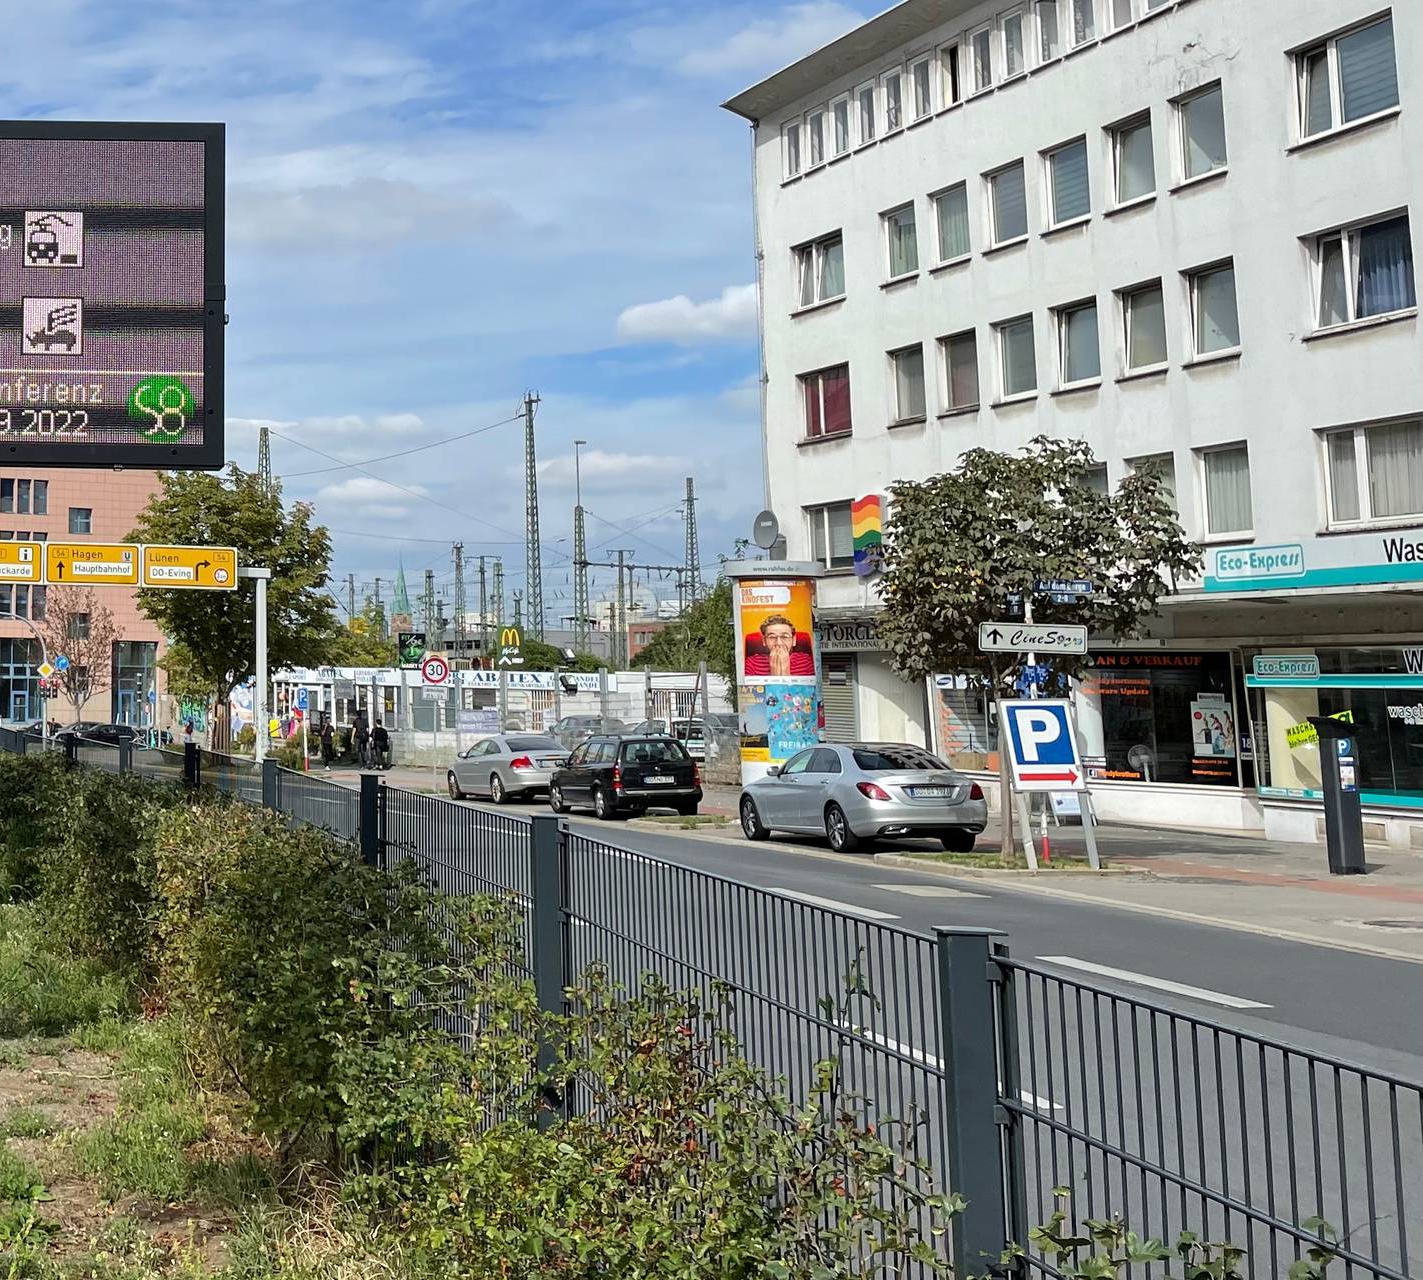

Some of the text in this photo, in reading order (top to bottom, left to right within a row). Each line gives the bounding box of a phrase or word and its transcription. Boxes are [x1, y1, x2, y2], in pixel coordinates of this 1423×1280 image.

[72, 550, 103, 560] Hagen
[150, 553, 179, 563] Lünen
[1219, 551, 1299, 572] Eco-Express
[74, 564, 130, 575] Hauptbahnhof
[152, 568, 192, 580] DO-Eving
[1134, 656, 1203, 666] VERKAUF
[1257, 660, 1316, 674] Eco-Express
[428, 664, 443, 676] 30
[1014, 709, 1061, 762] P
[1337, 739, 1347, 754] P
